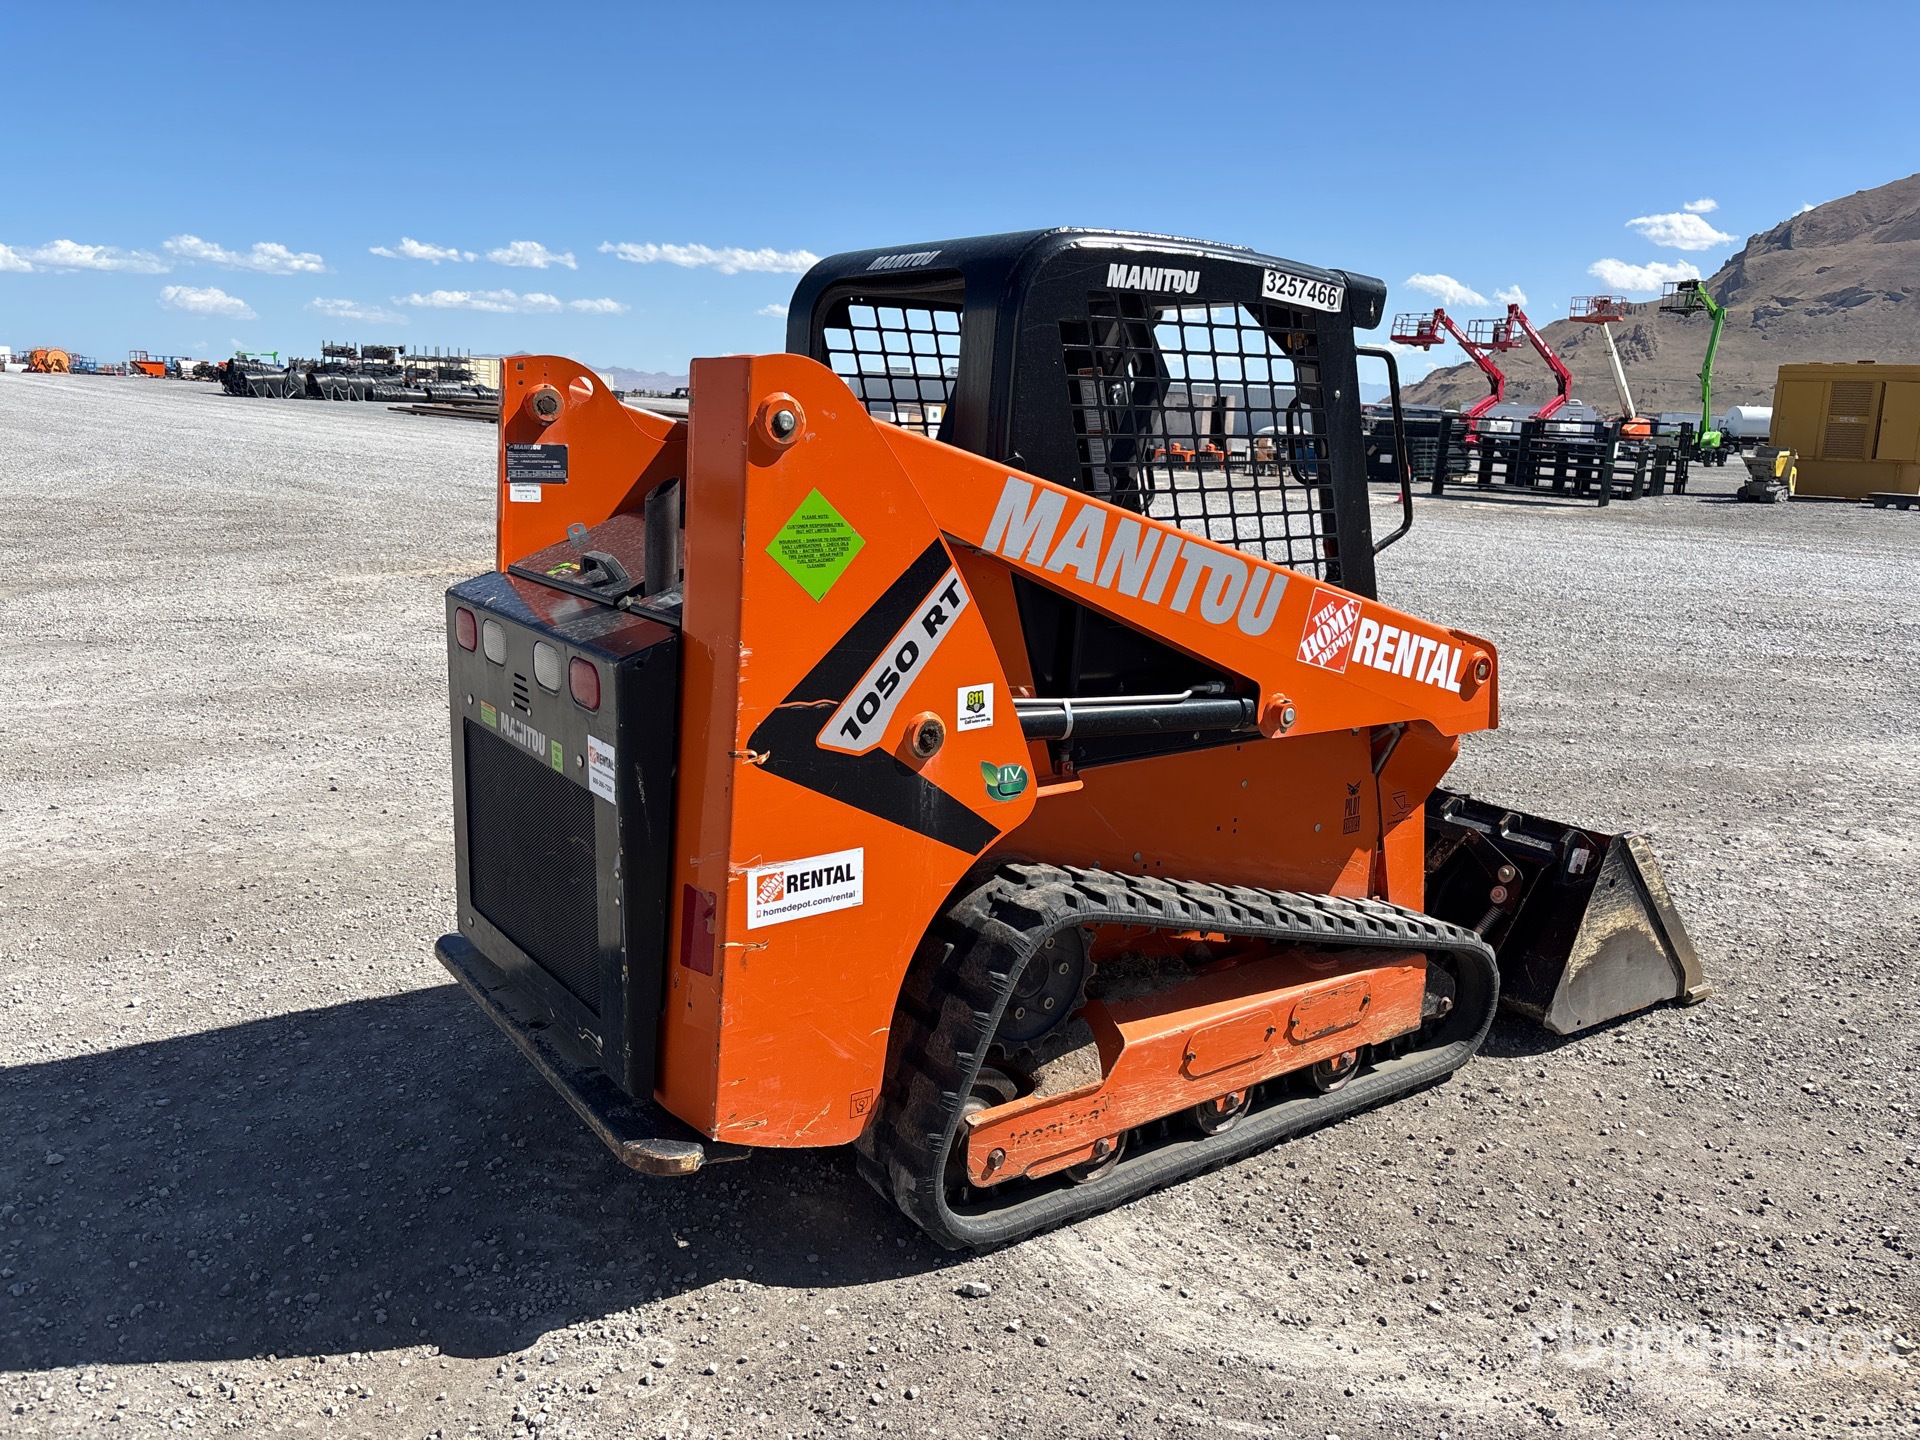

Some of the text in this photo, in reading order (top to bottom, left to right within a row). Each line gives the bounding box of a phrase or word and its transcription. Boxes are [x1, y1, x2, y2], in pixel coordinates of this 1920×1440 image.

[866, 250, 942, 270] MANITOU
[1107, 263, 1200, 294] MANITOU
[1265, 271, 1337, 306] 3257466
[982, 476, 1290, 636] MANITOU
[1312, 601, 1335, 628] THE
[1300, 600, 1359, 662] HOME
[840, 578, 961, 740] 1050 RT
[1317, 629, 1353, 666] DEPOT
[1352, 617, 1462, 693] RENTAL
[968, 691, 983, 706] 811
[501, 711, 546, 757] MANITOU
[757, 872, 784, 904] HOME
[759, 877, 771, 890] THE
[786, 863, 855, 894] RENTAL
[763, 890, 856, 917] homedepot.com/rental
